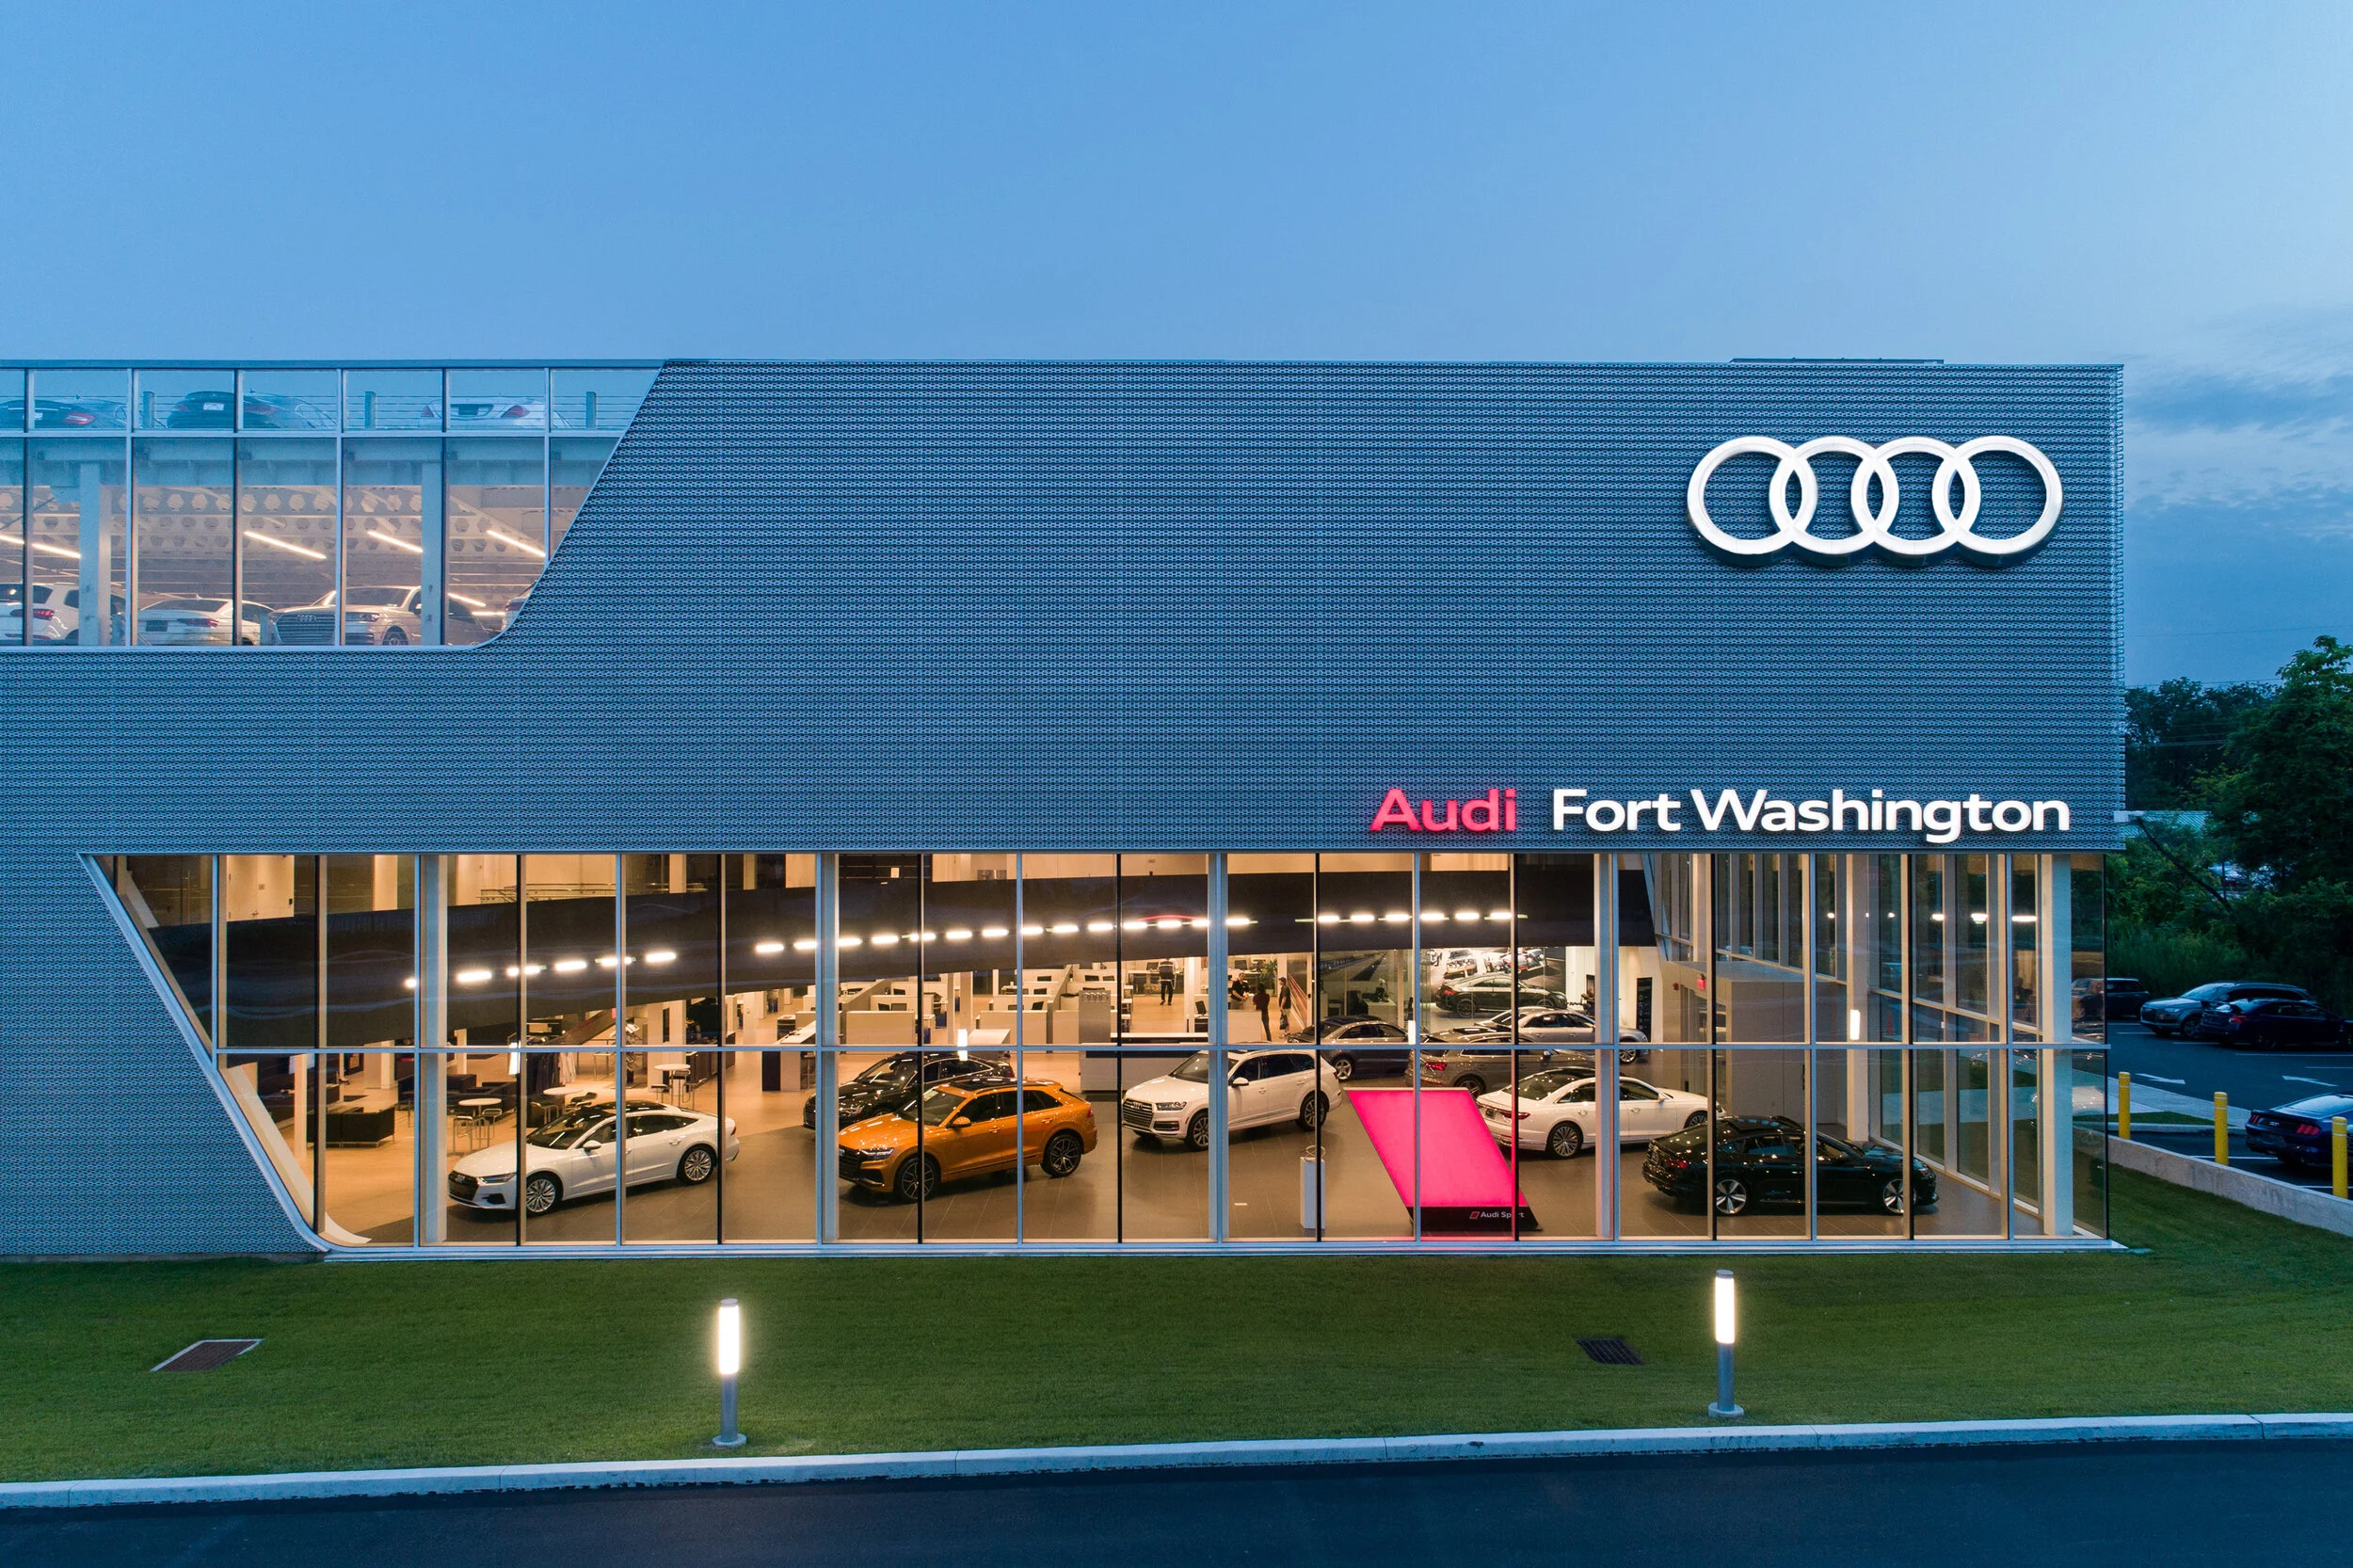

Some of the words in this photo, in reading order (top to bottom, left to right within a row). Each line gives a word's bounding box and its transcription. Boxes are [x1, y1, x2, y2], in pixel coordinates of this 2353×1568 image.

[1369, 788, 1516, 831] Audi
[1554, 789, 1681, 831] Fort
[1690, 789, 2071, 843] Washington
